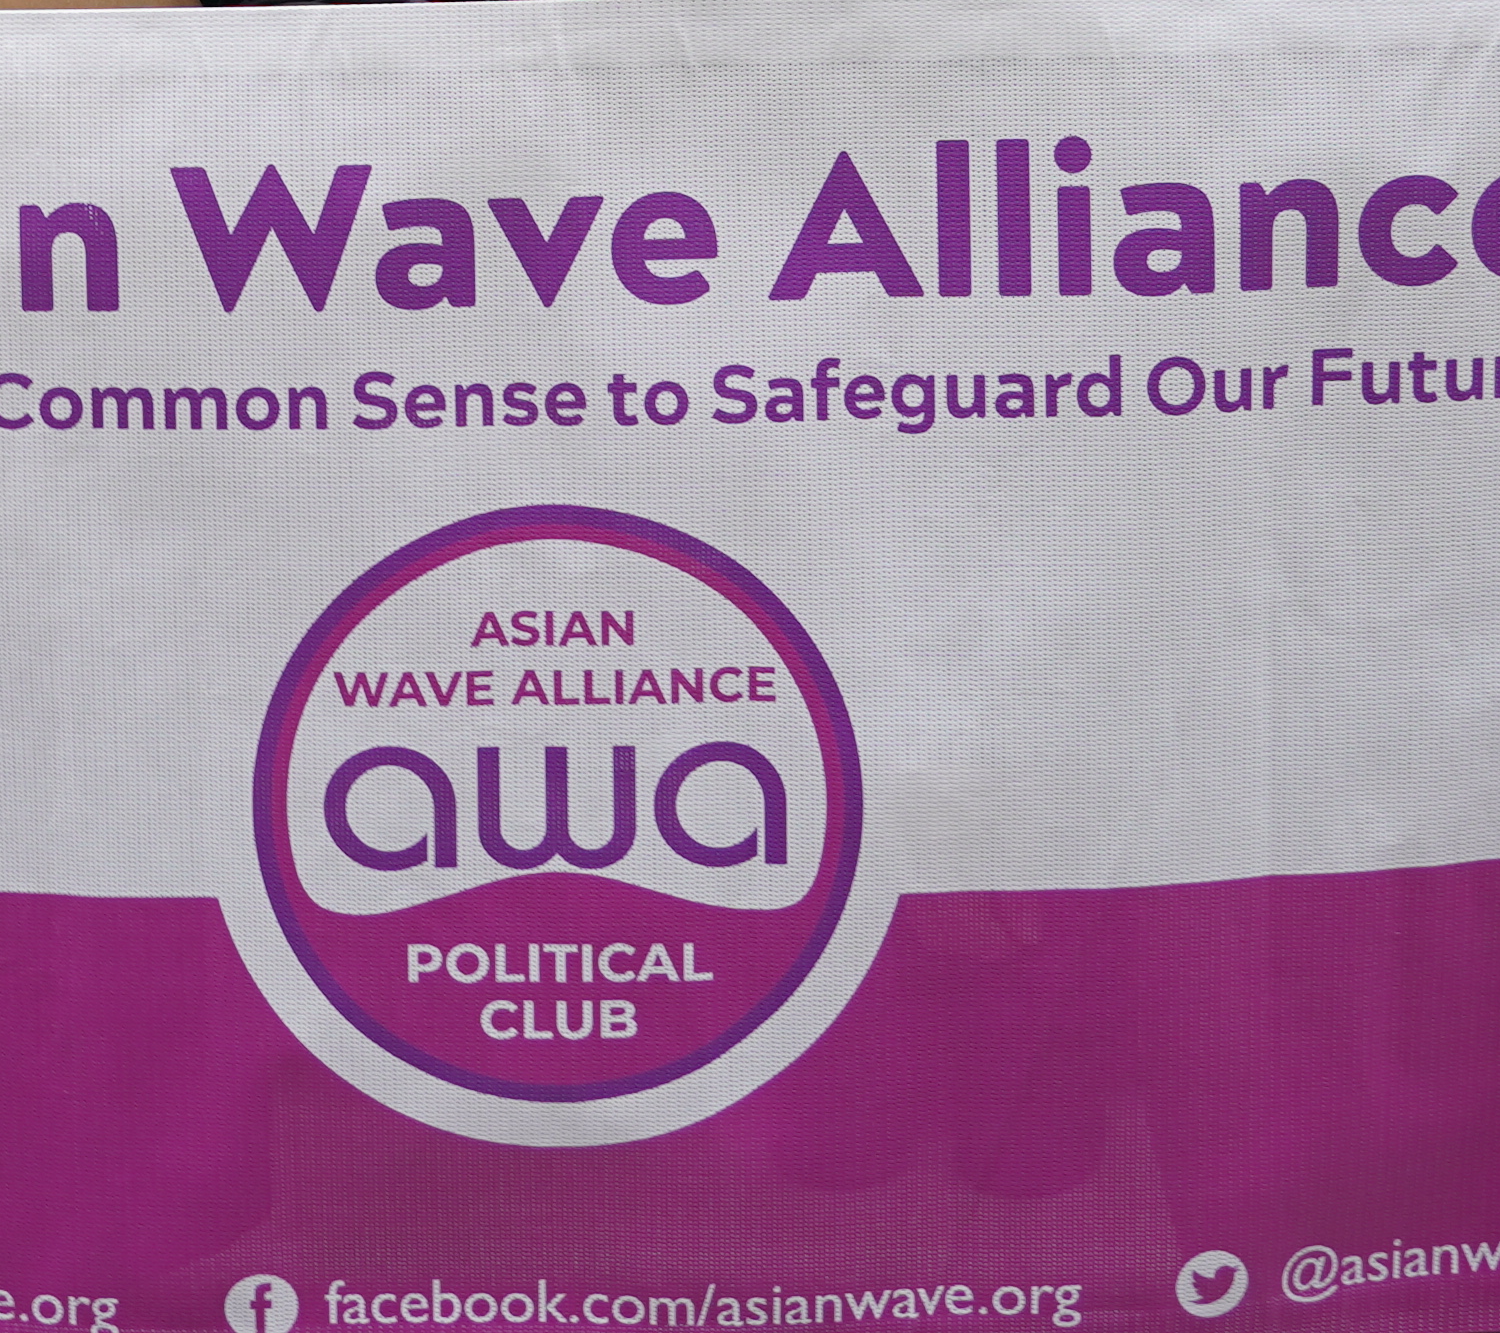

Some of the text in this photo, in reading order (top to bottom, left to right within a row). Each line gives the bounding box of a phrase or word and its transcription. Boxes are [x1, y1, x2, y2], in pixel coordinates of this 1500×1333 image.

[168, 162, 719, 314] Wave
[351, 369, 589, 431] Sense
[606, 371, 692, 428] to
[710, 353, 1124, 437] Safeguard
[1146, 354, 1291, 418] Our
[470, 608, 636, 647] ASIAN
[332, 666, 778, 708] WAVE ALLIANCE
[405, 940, 715, 984] POLITICAL
[479, 998, 640, 1041] CLUB
[324, 1277, 1084, 1329] facebook.com/asianwave.org
